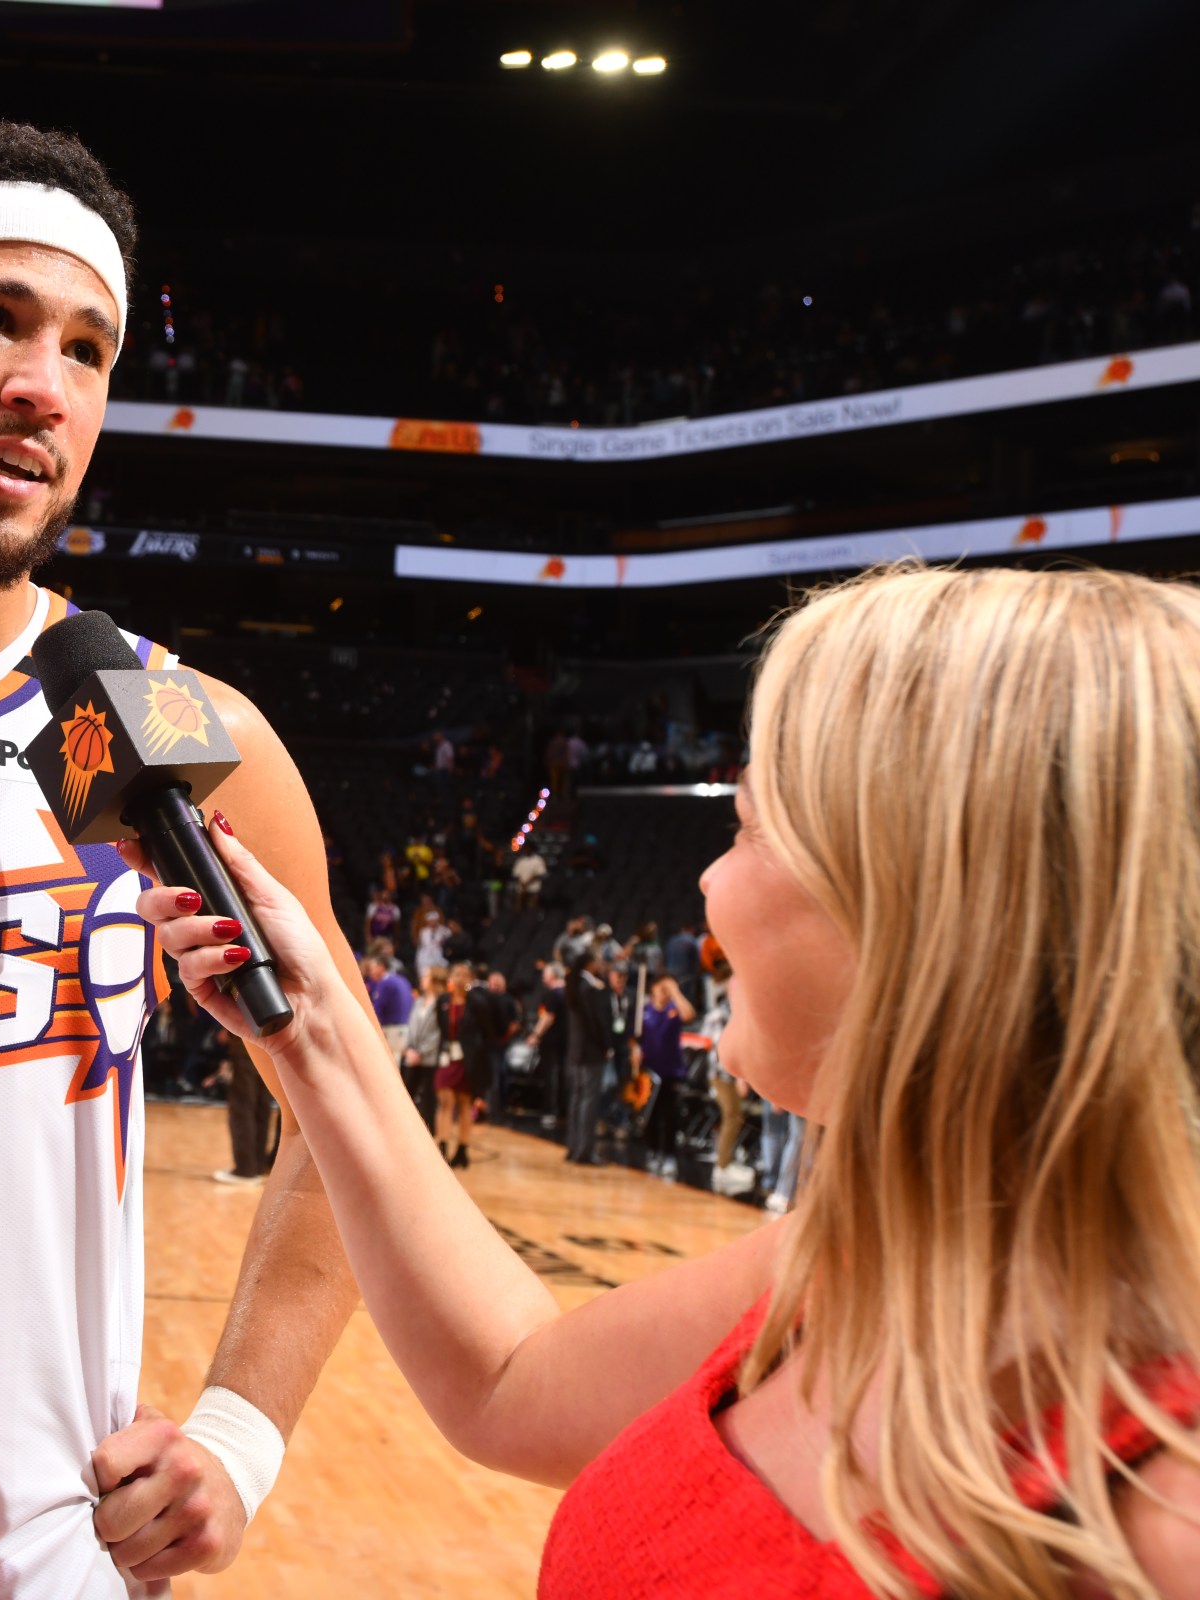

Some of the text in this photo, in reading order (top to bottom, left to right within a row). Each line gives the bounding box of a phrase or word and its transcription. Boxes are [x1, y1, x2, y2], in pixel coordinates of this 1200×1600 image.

[528, 395, 901, 458] Single Game Tickets on Sale Now!
